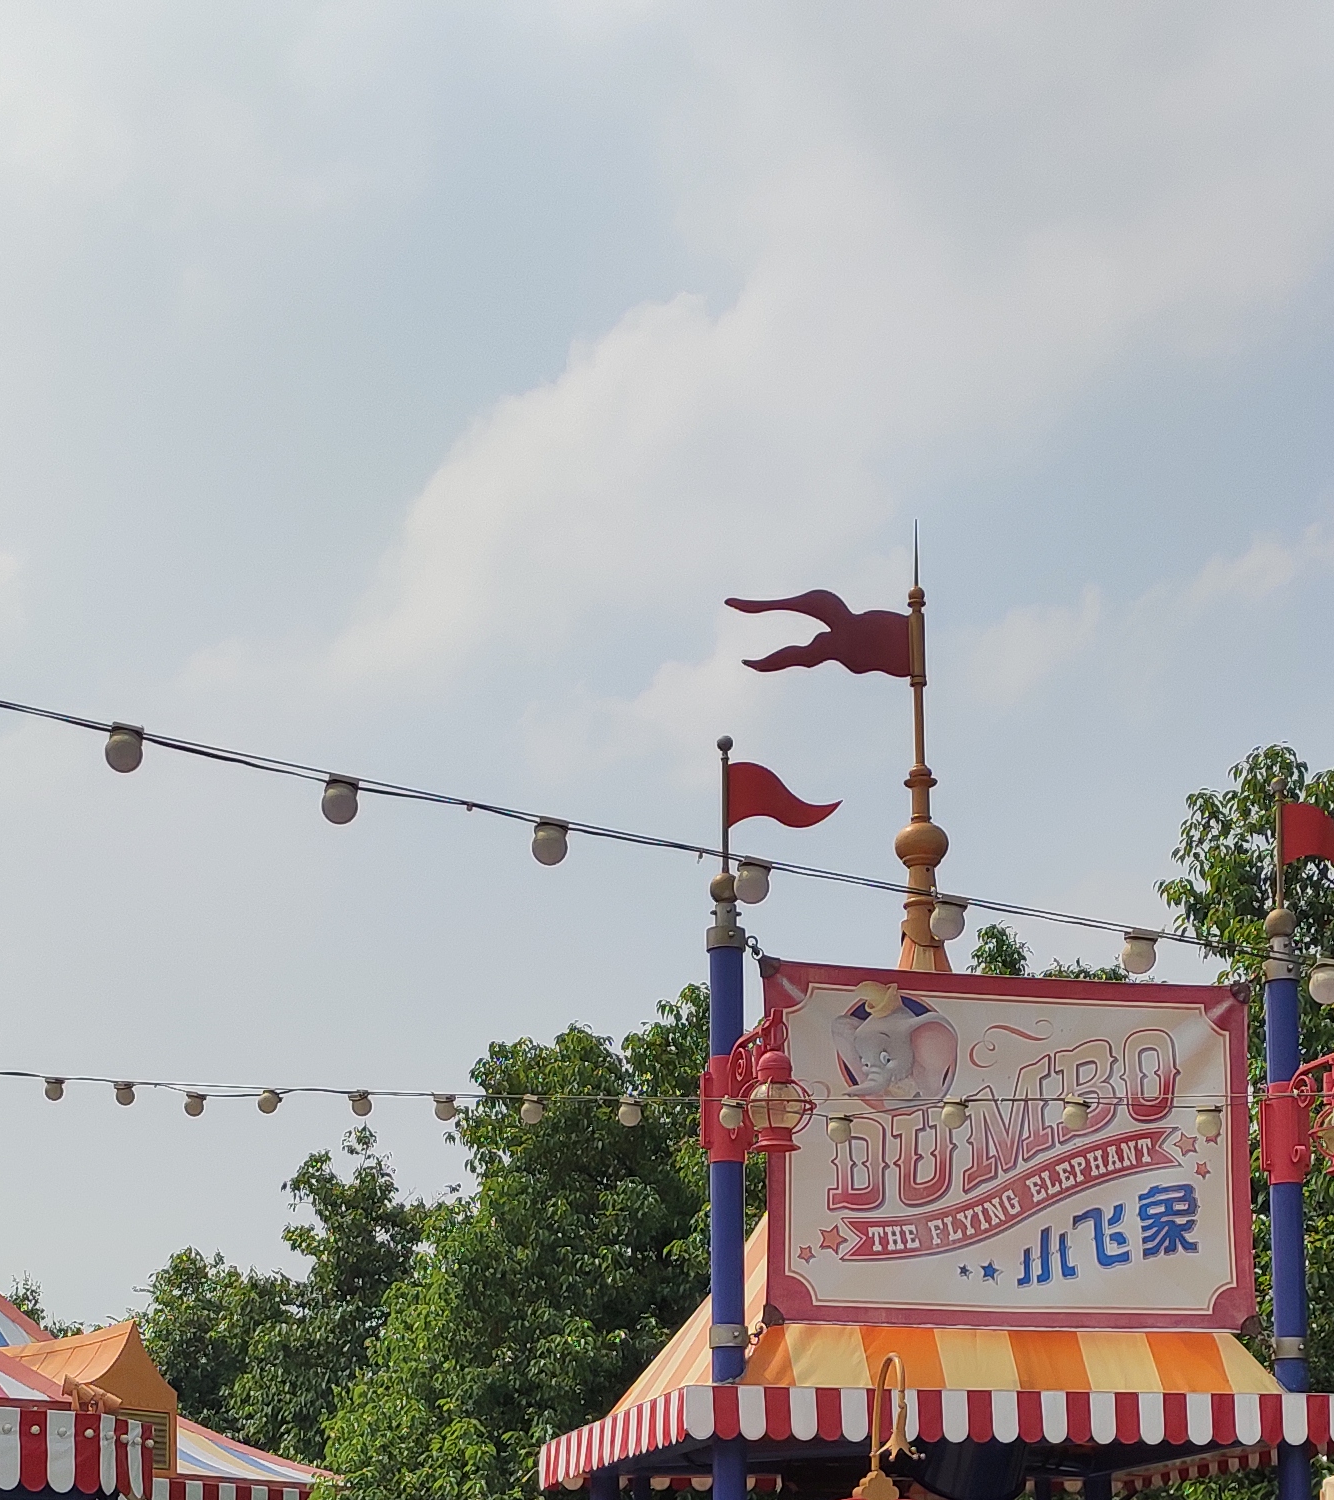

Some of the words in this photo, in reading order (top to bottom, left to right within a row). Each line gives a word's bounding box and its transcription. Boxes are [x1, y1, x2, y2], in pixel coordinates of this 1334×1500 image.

[827, 1027, 1178, 1212] DUMBO
[867, 1220, 918, 1253] THE
[930, 1188, 1021, 1247] FLYING
[1030, 1135, 1154, 1202] ELEPHANT
[1016, 1182, 1199, 1289] 小飞象
